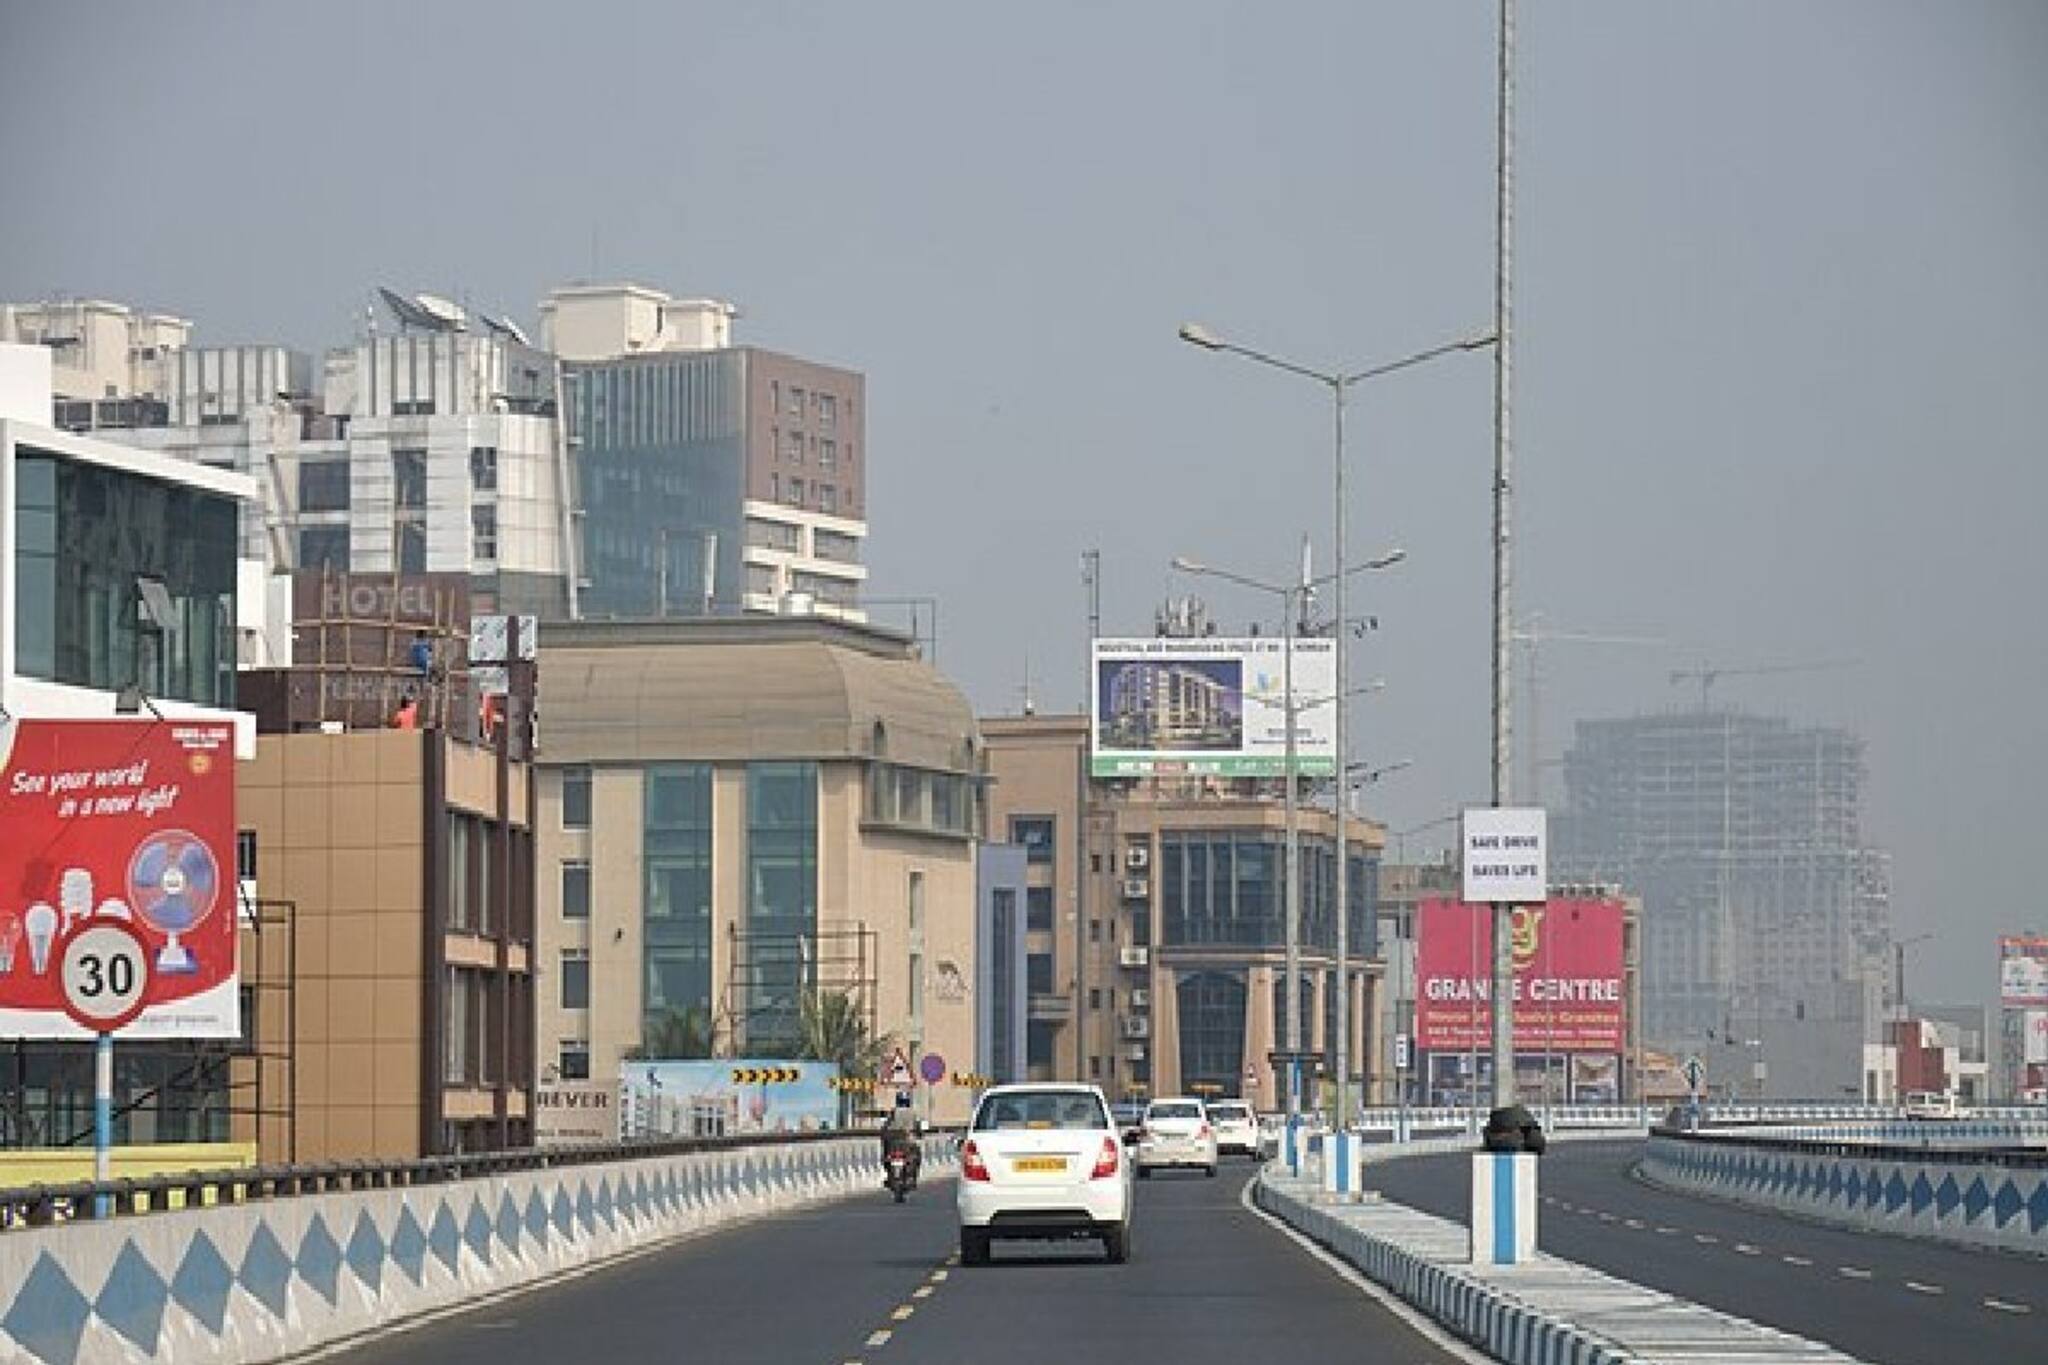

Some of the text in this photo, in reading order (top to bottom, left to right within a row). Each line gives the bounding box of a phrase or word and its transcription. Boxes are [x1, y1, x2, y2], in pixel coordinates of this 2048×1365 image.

[325, 583, 433, 616] HOTEL
[10, 759, 148, 797] See your world
[58, 784, 180, 818] in a new light
[1503, 836, 1538, 850] DRIVE
[1512, 864, 1538, 878] LIFE
[79, 953, 133, 998] 30
[1528, 978, 1620, 1001] CENTRE
